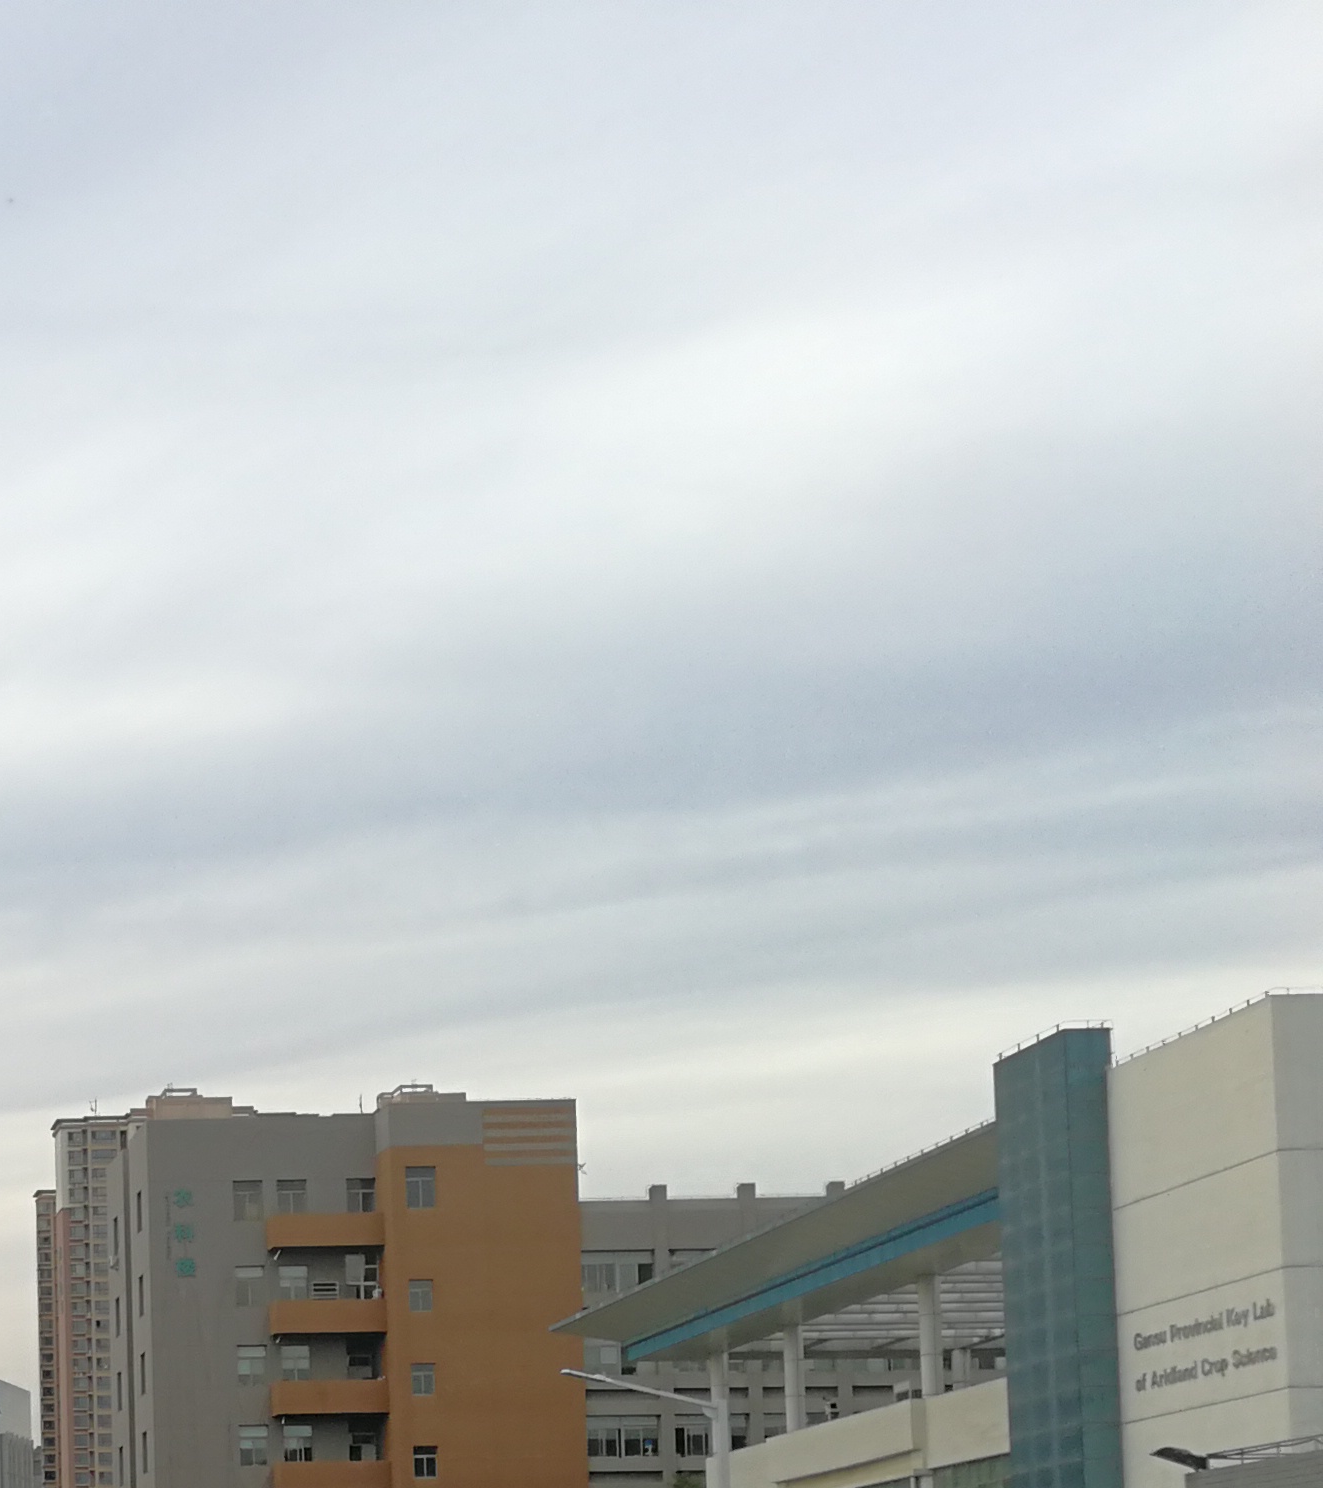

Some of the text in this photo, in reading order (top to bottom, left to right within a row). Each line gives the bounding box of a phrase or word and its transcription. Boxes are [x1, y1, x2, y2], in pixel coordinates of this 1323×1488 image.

[1134, 1298, 1275, 1351] Gansu Provincial Key Lab
[1135, 1372, 1146, 1392] of
[1201, 1358, 1228, 1377] Crop
[1232, 1346, 1278, 1369] Science
